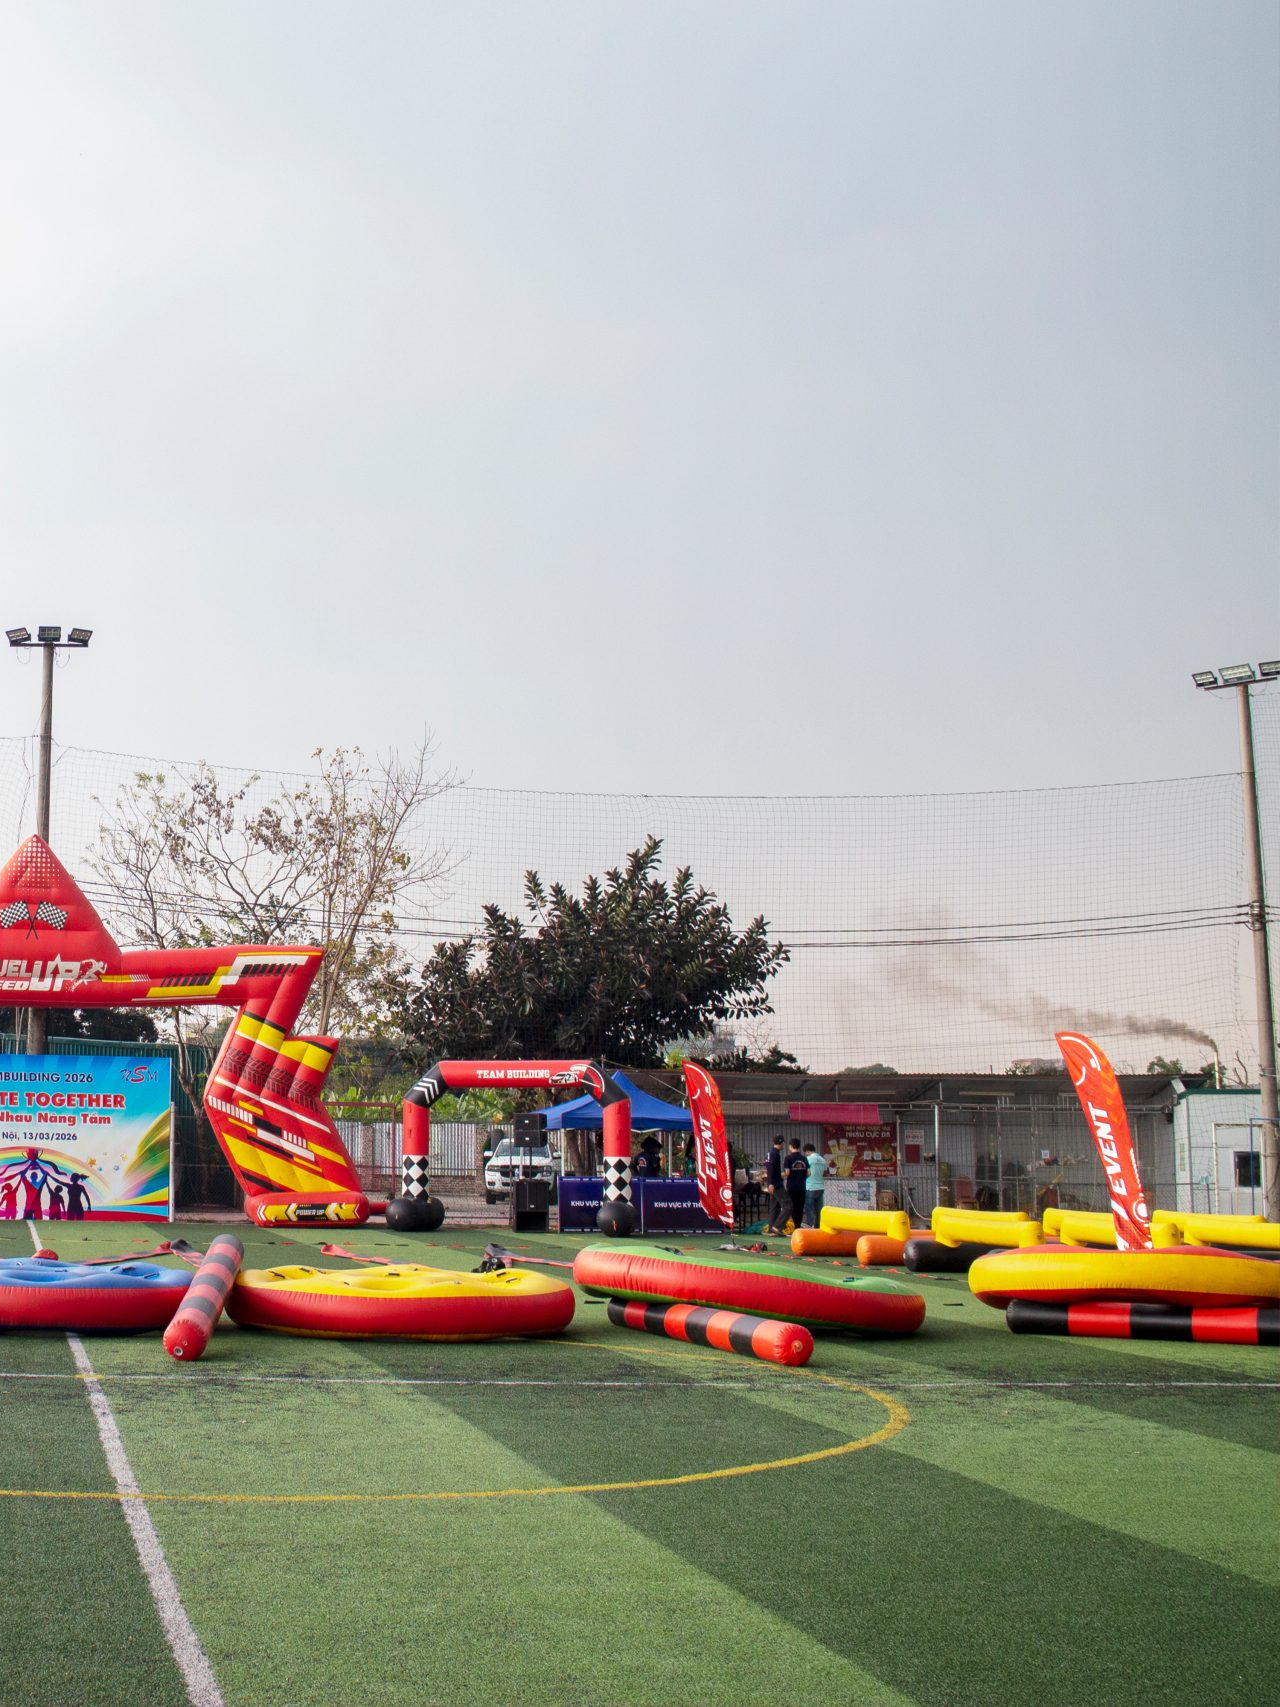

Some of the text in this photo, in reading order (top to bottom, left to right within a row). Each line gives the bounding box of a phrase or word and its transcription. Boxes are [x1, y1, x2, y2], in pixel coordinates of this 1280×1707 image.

[64, 1072, 93, 1083] 2026
[476, 1069, 551, 1079] TEAM BUILDING
[24, 1091, 127, 1110] TOGETHER
[37, 1112, 77, 1127] Nâng
[2, 1131, 20, 1142] Nội,
[23, 1132, 78, 1142] 13/03/2026
[699, 1112, 718, 1181] EVENT
[1087, 1101, 1128, 1197] EVENT
